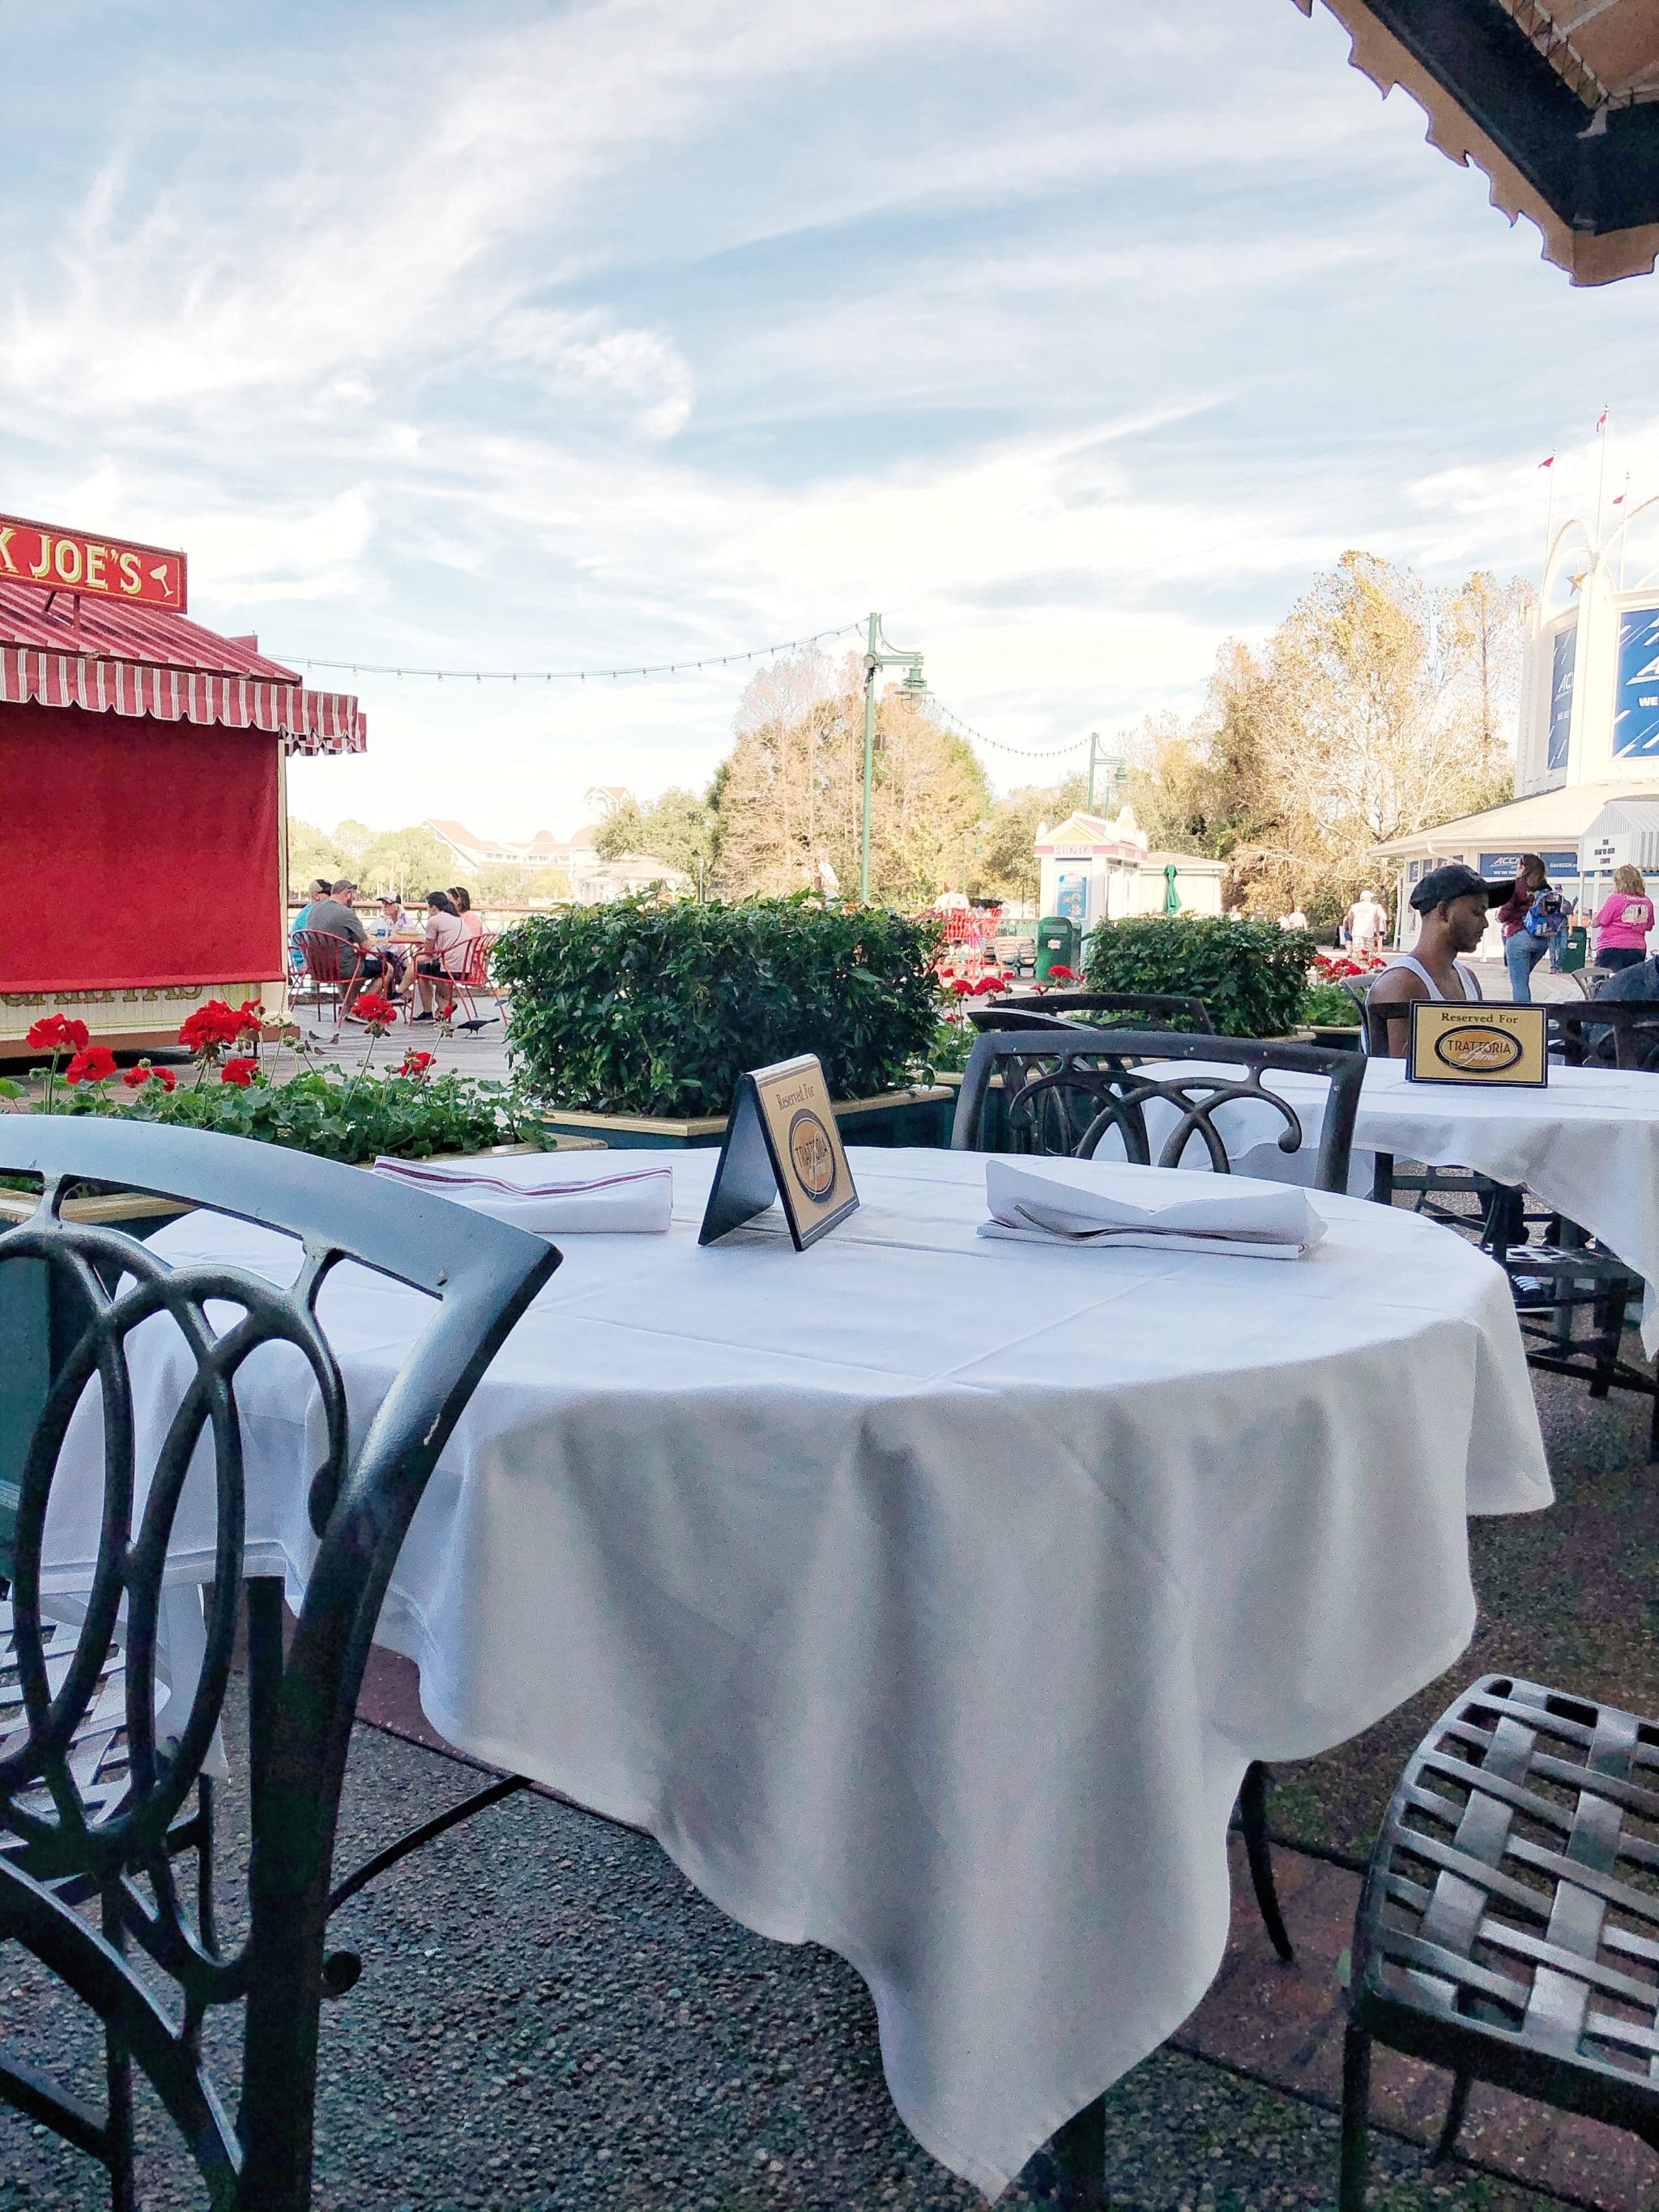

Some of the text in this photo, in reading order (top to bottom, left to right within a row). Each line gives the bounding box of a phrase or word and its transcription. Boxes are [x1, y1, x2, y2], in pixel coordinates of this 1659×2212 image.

[29, 534, 142, 595] JOE'S
[1638, 697, 1659, 707] WE
[1053, 845, 1094, 855] PHOTOS
[1441, 1012, 1518, 1024] Reserved For
[1448, 1040, 1512, 1055] TRATTORIA
[775, 1083, 815, 1111] Reserved For
